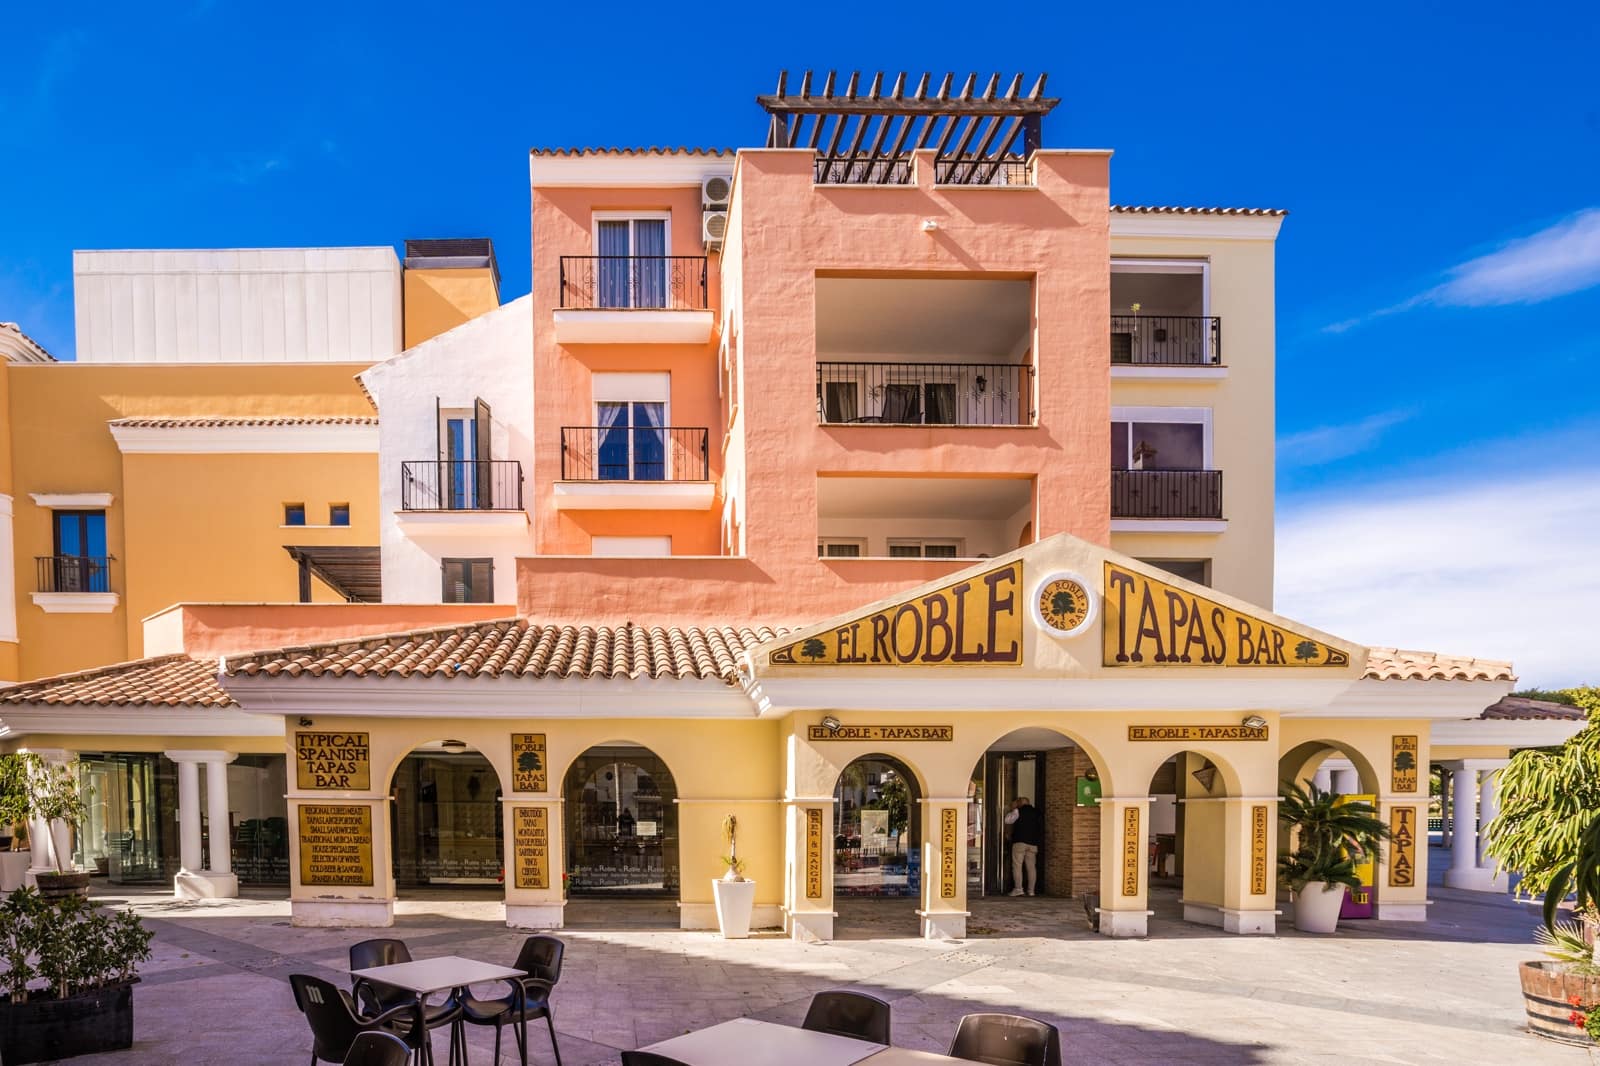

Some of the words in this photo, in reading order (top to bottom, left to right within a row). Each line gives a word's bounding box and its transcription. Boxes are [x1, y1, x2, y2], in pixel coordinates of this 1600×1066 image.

[1041, 590, 1053, 601] EL
[1056, 581, 1084, 602] ROBLE
[836, 623, 867, 663] EL
[871, 567, 1018, 663] ROBLE
[1040, 605, 1066, 629] TAPAS
[1069, 608, 1086, 626] BAR
[1110, 569, 1227, 664] TAPAS
[1236, 617, 1287, 665] BAR
[298, 734, 367, 747] TYPICAL
[813, 728, 827, 738] EL
[830, 728, 870, 738] ROBLE
[880, 728, 920, 738] TAPAS
[922, 728, 948, 738] BAR
[1133, 728, 1147, 738] EL
[1150, 728, 1189, 738] ROBLE
[1199, 728, 1237, 738] TAPAS
[1240, 728, 1264, 738] BAR
[299, 748, 367, 761] SPANISH
[307, 761, 357, 774] TAPAS
[315, 775, 351, 787] BAR
[523, 819, 537, 827] TAPAS
[944, 810, 953, 842] TYPICAL
[1256, 808, 1264, 844] CERVEZA
[1127, 841, 1136, 854] BAR
[1393, 809, 1412, 884] TAPAS
[944, 847, 953, 878] SPANISH
[1127, 859, 1136, 867] DE
[810, 851, 819, 896] SANGRIA
[1126, 872, 1135, 894] TAPAS
[1255, 857, 1264, 892] SANGRIA
[944, 882, 952, 896] BAR
